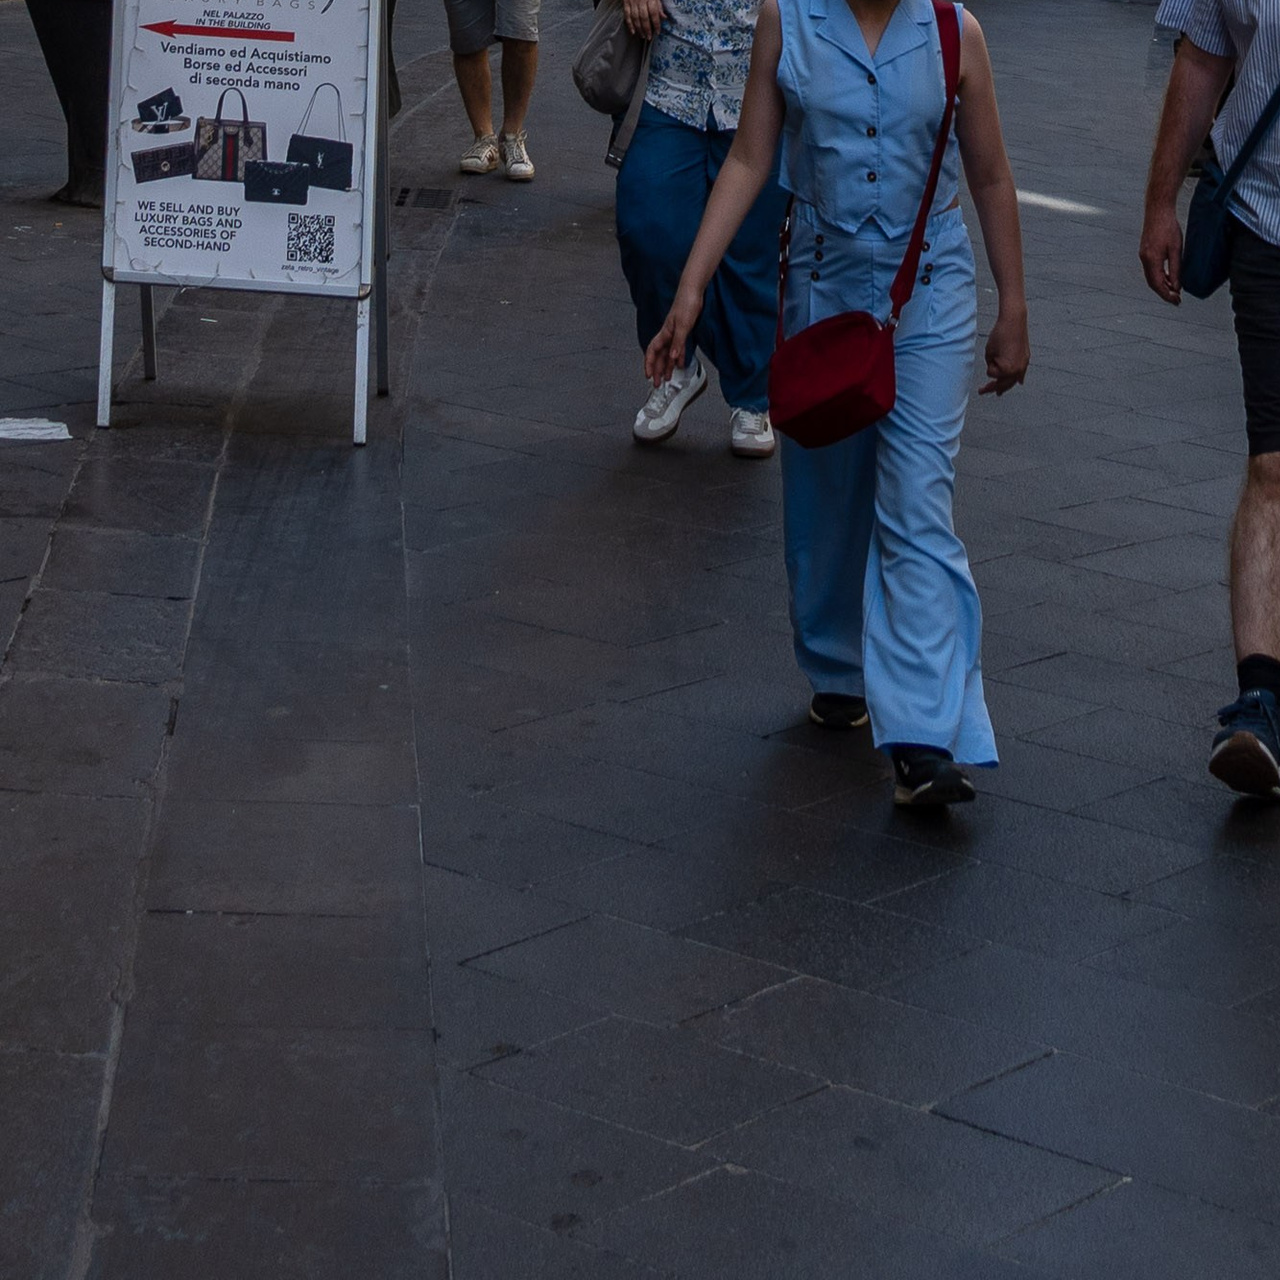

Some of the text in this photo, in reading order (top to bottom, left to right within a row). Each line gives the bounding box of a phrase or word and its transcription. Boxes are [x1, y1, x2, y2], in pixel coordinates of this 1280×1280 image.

[203, 9, 265, 21] NEL PALAZZO
[195, 18, 271, 30] IN THE BUILDING
[160, 41, 332, 65] Vendiamo ed Acquistiamo
[184, 57, 308, 77] Borse ed Accessori
[189, 72, 301, 91] di seconda mano
[137, 201, 241, 217] WE SELL AND BUY
[134, 212, 243, 229] LUXURY BAGS AND
[139, 225, 237, 241] ACCESSORIES OF
[143, 236, 231, 252] SECOND-HAND
